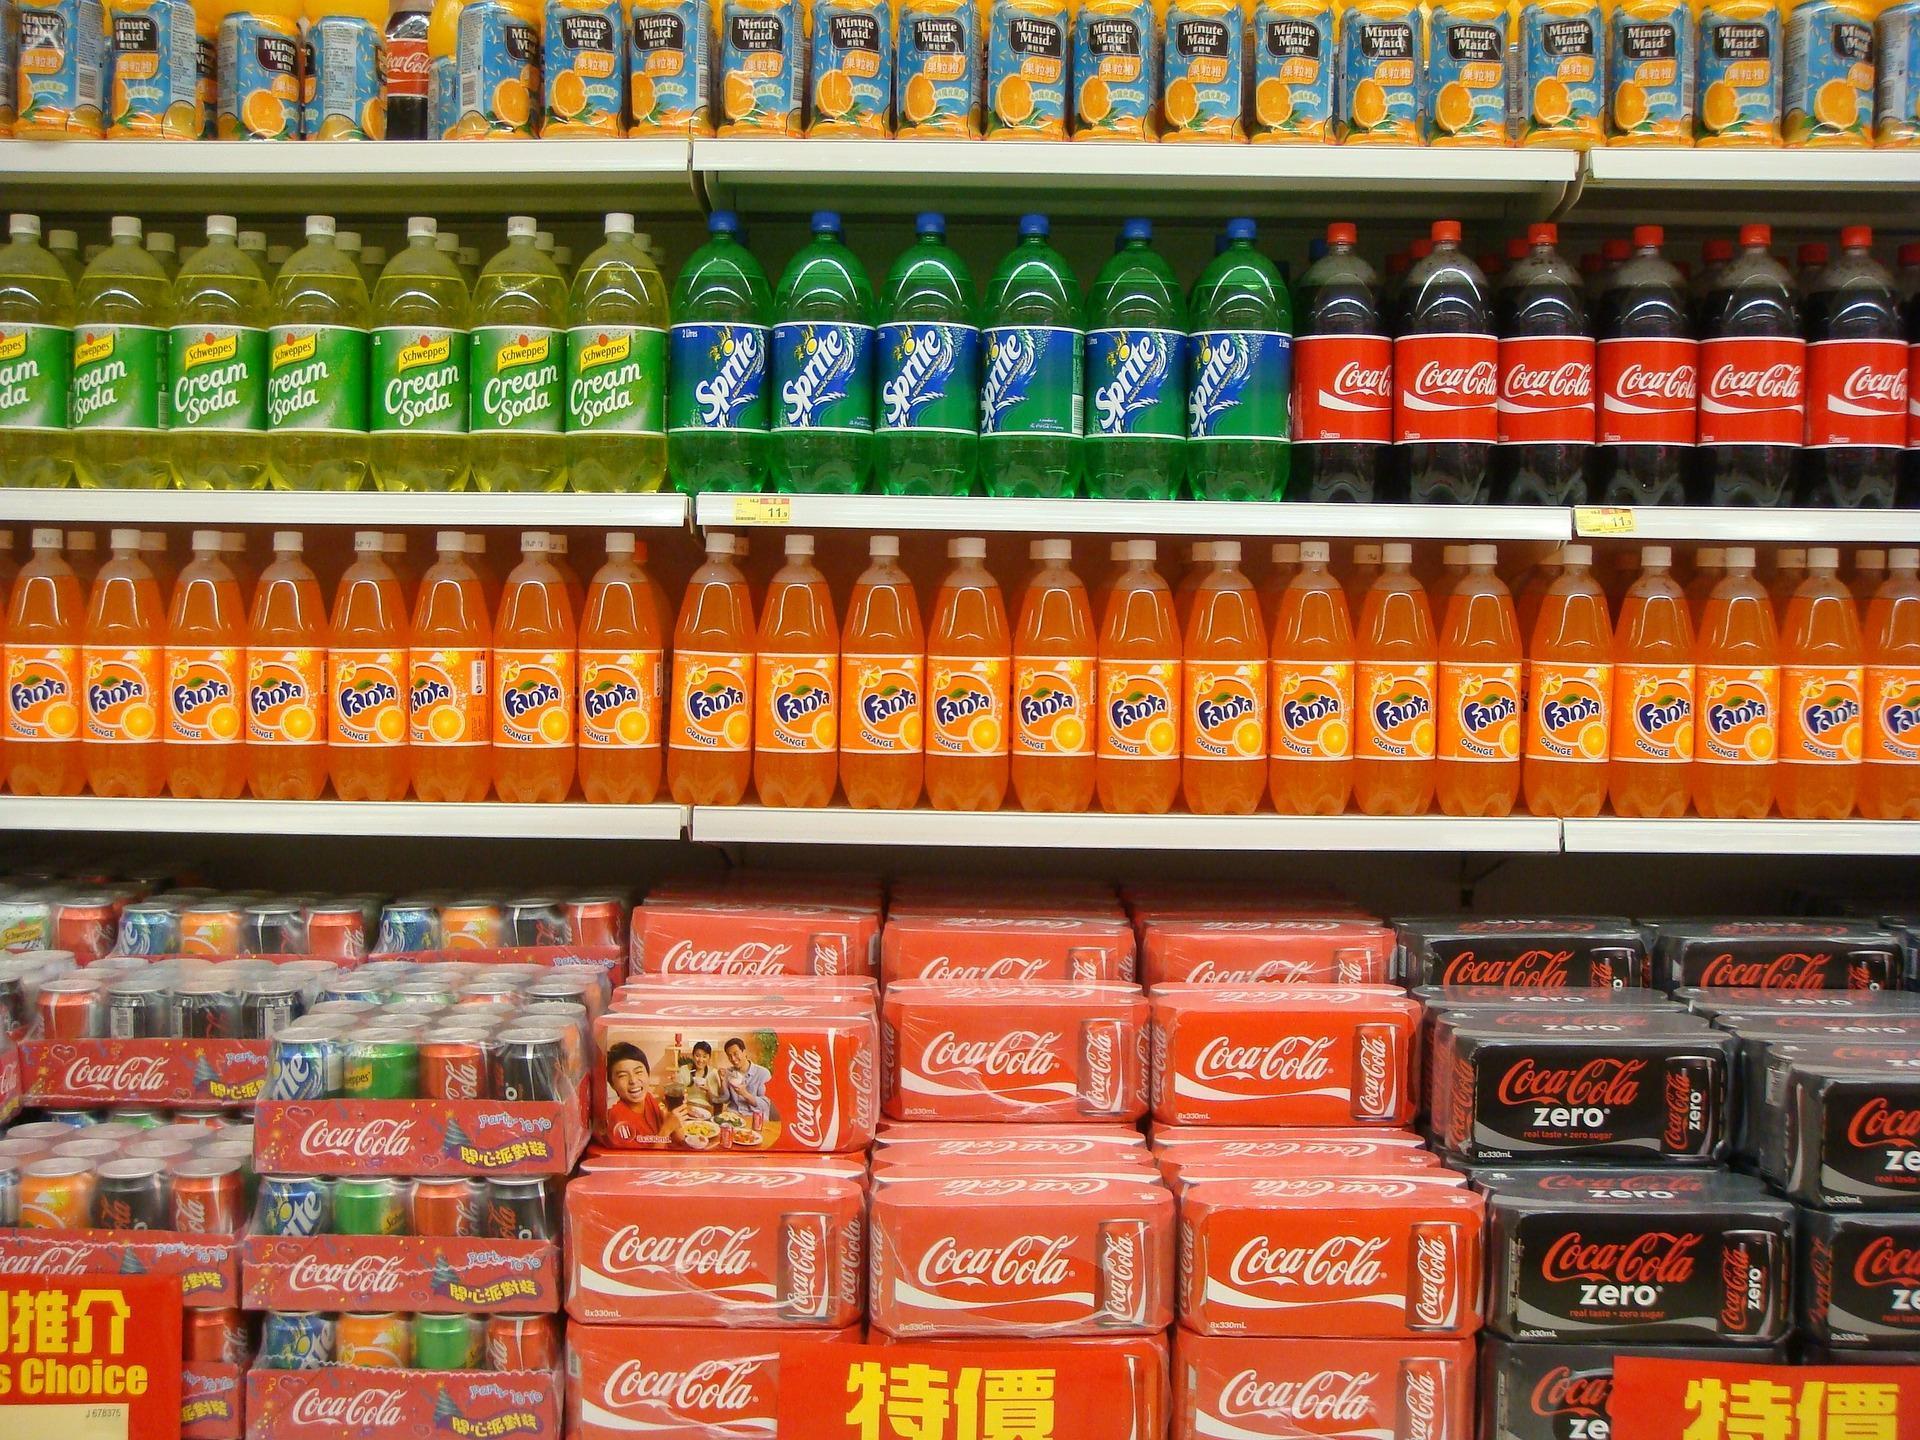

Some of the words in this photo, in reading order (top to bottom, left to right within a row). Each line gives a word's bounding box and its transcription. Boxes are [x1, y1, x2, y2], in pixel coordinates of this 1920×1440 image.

[566, 17, 607, 30] Minute
[571, 28, 603, 40] Maid
[639, 17, 679, 30] Minute
[644, 28, 673, 40] Maid
[738, 17, 780, 30] Minute
[743, 28, 776, 40] Maid
[834, 17, 874, 30] Minute
[838, 27, 870, 40] Maid
[917, 21, 957, 34] Minute
[922, 31, 951, 42] Maid
[1016, 21, 1056, 36] Minute
[1021, 32, 1051, 45] Maid
[1093, 22, 1133, 36] Minute
[1097, 32, 1128, 45] Maid
[1183, 23, 1223, 36] Minute
[1187, 33, 1218, 46] Maid
[1273, 23, 1315, 36] Minute
[1278, 33, 1310, 46] Maid
[1365, 23, 1409, 36] Minute
[1371, 34, 1402, 47] Maid
[1454, 27, 1496, 40] Minute
[1549, 24, 1589, 37] Minute
[1554, 35, 1585, 46] Maid
[1628, 27, 1671, 40] Minute
[1719, 27, 1762, 40] Minute
[1459, 38, 1489, 50] Maid
[1633, 38, 1666, 50] Maid
[1723, 38, 1756, 50] Maid
[188, 342, 233, 361] Schweppes
[274, 342, 312, 363] Schweppes
[402, 345, 447, 364] Schweppes
[502, 345, 546, 363] Schweppes
[583, 344, 626, 363] Schweppes
[175, 361, 248, 413] Cream
[385, 365, 460, 415] Cream
[483, 364, 558, 414] Cream
[571, 363, 642, 416] Cream
[695, 331, 757, 423] Sprite
[783, 330, 843, 423] Sprite
[883, 330, 942, 423] Sprite
[1095, 336, 1155, 430] Sprite
[1189, 338, 1237, 431] Sprite
[1504, 362, 1592, 398] Coca-Cola
[1711, 363, 1801, 398] Coca-Cola
[187, 387, 240, 424] Soda
[272, 386, 320, 425] Soda
[400, 390, 452, 426] Soda
[498, 390, 551, 426] Soda
[581, 391, 634, 427] Soda
[11, 679, 66, 712] Fanta
[90, 680, 143, 714] Fanta
[173, 680, 229, 714] Fanta
[250, 680, 302, 716] Fanta
[340, 682, 396, 718] Fanta
[503, 683, 560, 718] Fanta
[584, 684, 637, 719] Fanta
[690, 687, 744, 722] Fanta
[777, 688, 830, 723] Fanta
[863, 688, 916, 724] Fanta
[936, 690, 990, 726] Fanta
[1020, 691, 1074, 725] Fanta
[1111, 694, 1166, 729] Fanta
[1198, 695, 1253, 729] Fanta
[1283, 695, 1339, 729] Fanta
[1375, 696, 1429, 731] Fanta
[1464, 697, 1516, 733] Fanta
[1544, 697, 1600, 732] Fanta
[1638, 698, 1690, 733] Fanta
[1709, 699, 1766, 734] Fanta
[1806, 698, 1858, 734] Fanta
[339, 724, 369, 742] ORANGE
[503, 724, 533, 742] ORANGE
[686, 727, 717, 745] ORANGE
[774, 729, 806, 748] ORANGE
[861, 730, 893, 748] ORANGE
[1542, 1024, 1622, 1032] zero
[921, 1031, 1063, 1075] Coca-Cola
[1086, 1030, 1113, 1109] Coca-Cola
[1195, 1036, 1338, 1081] Coca-Cola
[66, 1056, 170, 1090] Coca-Cola
[1360, 1035, 1387, 1115] Coca-Cola
[1498, 1057, 1648, 1106] Coca-Cola
[789, 1044, 823, 1147] Coca-Cola
[1689, 1091, 1701, 1131] zero
[1533, 1108, 1605, 1127] zero
[301, 1119, 416, 1157] Coca-Cola
[1588, 1189, 1674, 1199] zero
[602, 1224, 761, 1275] Coca-Cola
[918, 1236, 1079, 1286] Coca-Cola
[1230, 1236, 1391, 1286] Coca-Cola
[1542, 1232, 1703, 1284] Coca-Cola
[289, 1254, 406, 1293] Coca-Cola
[787, 1223, 816, 1314] Coca-Cola
[1103, 1232, 1134, 1320] Coca-Cola
[1415, 1234, 1446, 1325] Coca-Cola
[1580, 1284, 1657, 1306] zero
[1747, 1267, 1761, 1310] zero
[0, 1290, 131, 1354] 推介
[21, 1358, 148, 1395] Choice
[604, 1359, 761, 1409] Coca-Cola
[292, 1388, 408, 1426] Coca-Cola
[846, 1361, 1056, 1440] 特價
[1218, 1369, 1380, 1420] Coca-Cola
[1683, 1378, 1900, 1440] 特價
